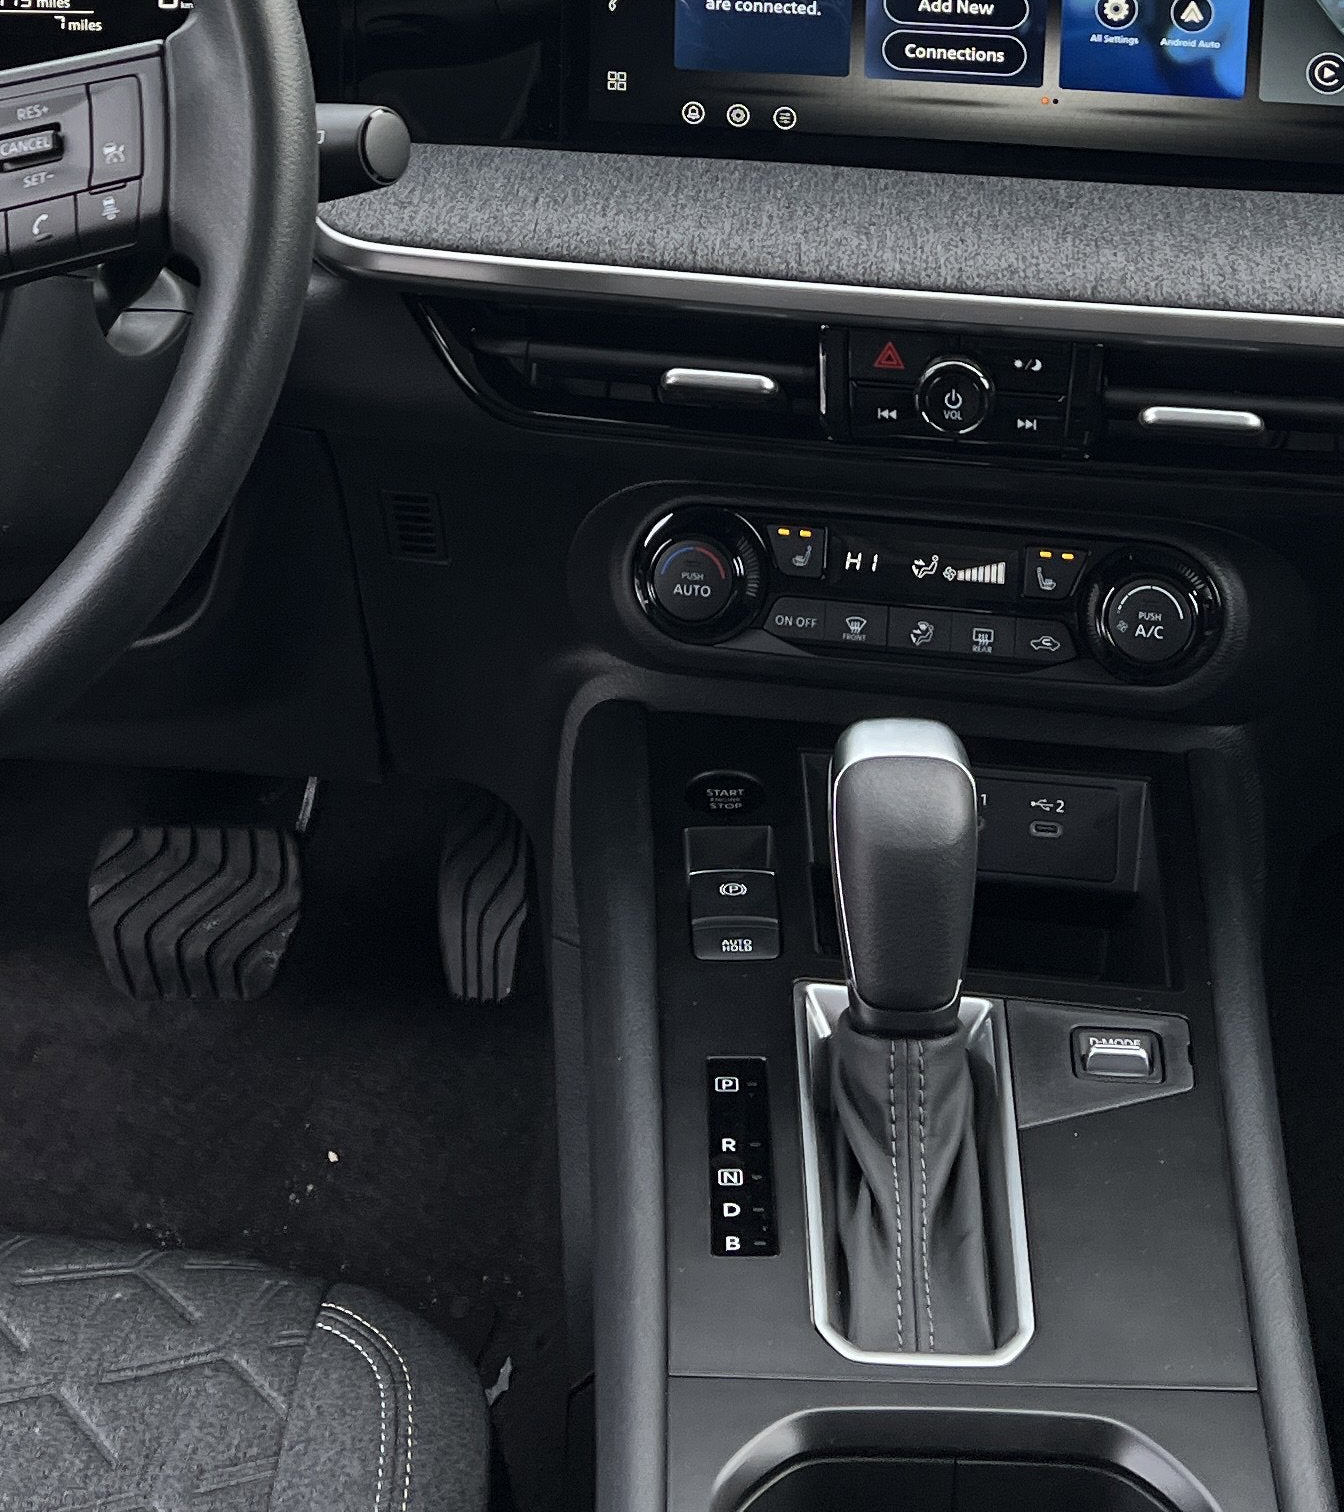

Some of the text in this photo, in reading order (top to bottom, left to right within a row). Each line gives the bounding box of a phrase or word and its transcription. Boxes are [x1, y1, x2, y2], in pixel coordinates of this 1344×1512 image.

[705, 0, 731, 12] are
[67, 18, 103, 32] miles
[1090, 33, 1139, 46] All Settings
[1160, 37, 1221, 49] Android Auto
[904, 43, 1005, 63] Connections
[0, 136, 53, 157] CANCEL
[943, 409, 963, 421] VOL
[681, 571, 704, 581] PUSH
[673, 583, 711, 598] AUTO
[774, 614, 818, 628] ON OFF
[1138, 611, 1162, 622] PUSH
[842, 633, 867, 641] FRONT
[1134, 623, 1164, 640] A/C
[972, 644, 992, 654] REAR
[706, 788, 745, 797] START
[980, 793, 988, 806] 1
[1055, 799, 1065, 814] 2
[721, 938, 753, 946] AUTO
[722, 945, 753, 953] HOLD
[721, 1079, 734, 1091] P
[721, 1137, 736, 1152] R
[723, 1170, 739, 1185] N
[722, 1202, 741, 1218] D
[725, 1235, 741, 1251] B
